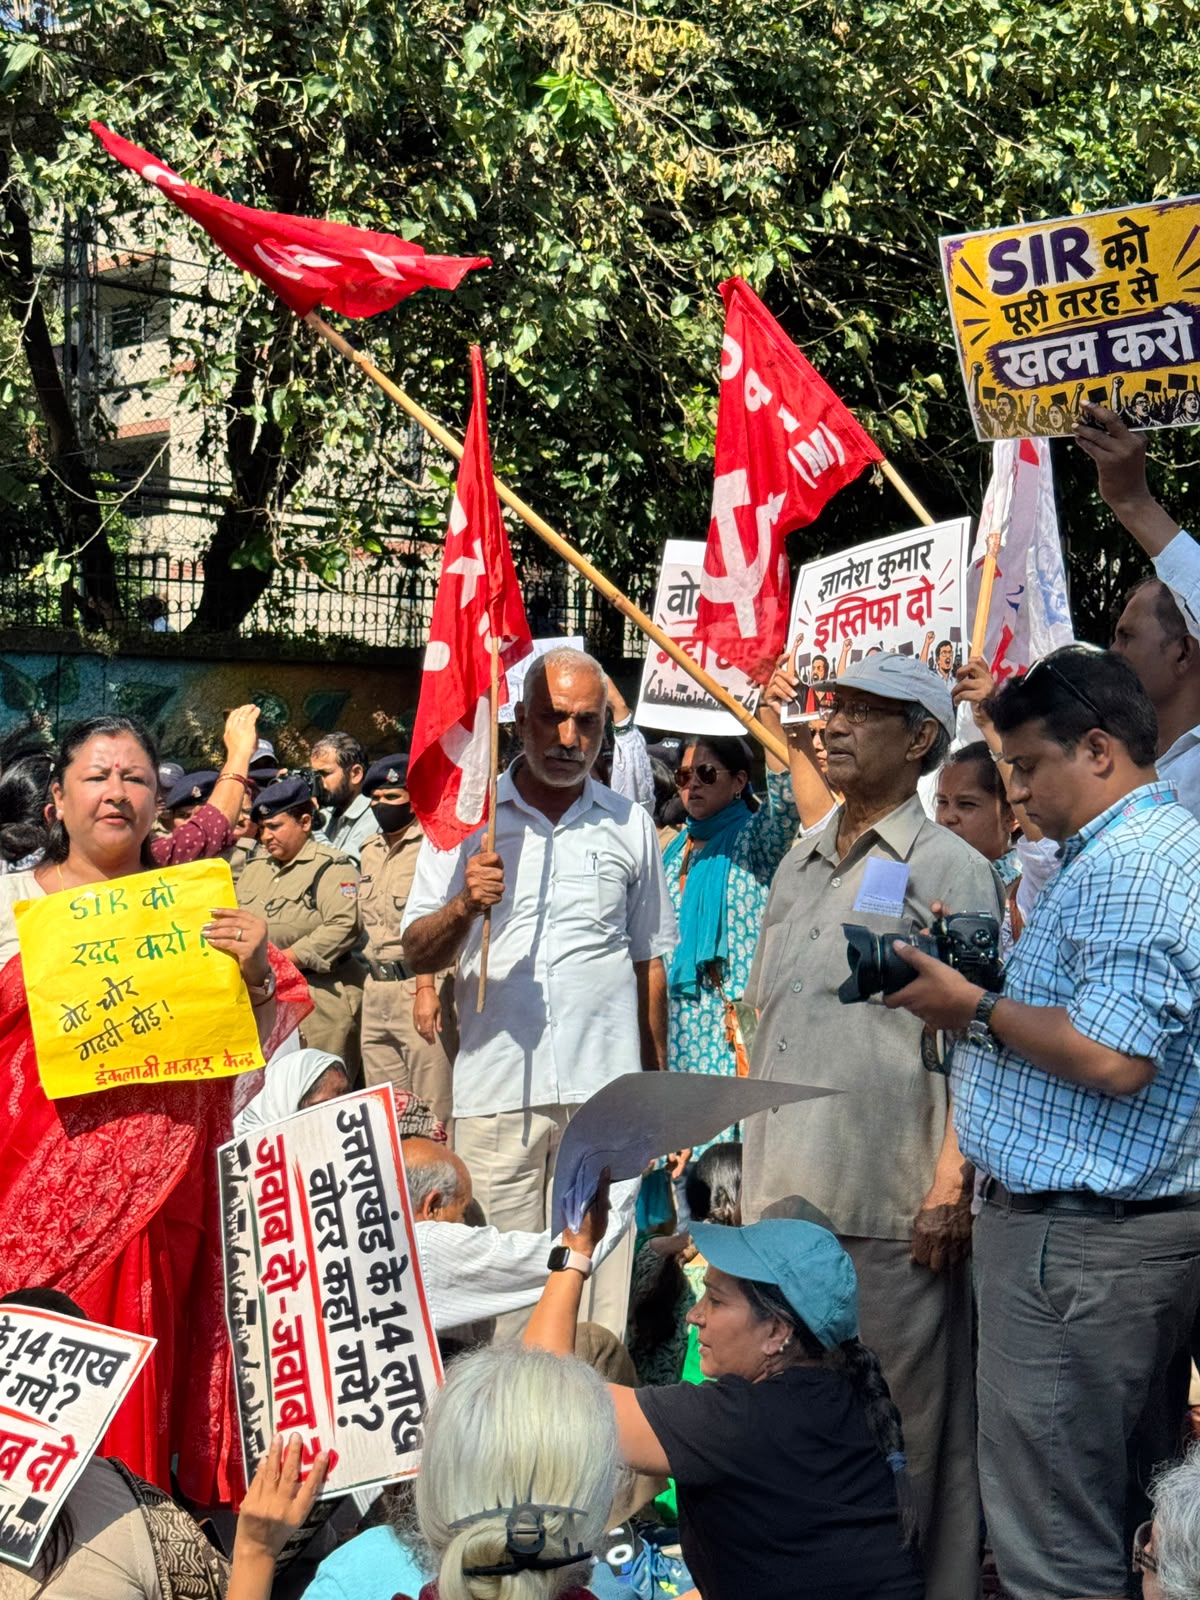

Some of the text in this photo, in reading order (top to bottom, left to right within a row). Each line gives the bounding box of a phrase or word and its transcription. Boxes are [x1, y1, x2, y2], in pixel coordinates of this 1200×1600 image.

[988, 216, 1150, 296] SIR को
[1001, 268, 1159, 335] पूरी तरह से
[998, 305, 1194, 388] खत्म करो
[667, 570, 701, 617] वो
[817, 538, 935, 602] ज्ञानेश कुमार
[814, 575, 935, 653] इस्तिफा दो
[70, 876, 178, 920] SIR को
[135, 921, 191, 960] करो
[59, 976, 139, 1033] वोट चोर
[255, 1134, 294, 1247] जवाब
[309, 1162, 348, 1253] वोटर
[322, 1257, 371, 1332] कहां
[337, 1102, 429, 1455] उत्तराखंड के 14 लाख
[6, 1328, 53, 1365] 14
[48, 1337, 131, 1388] लाख
[26, 1434, 79, 1493] दो
